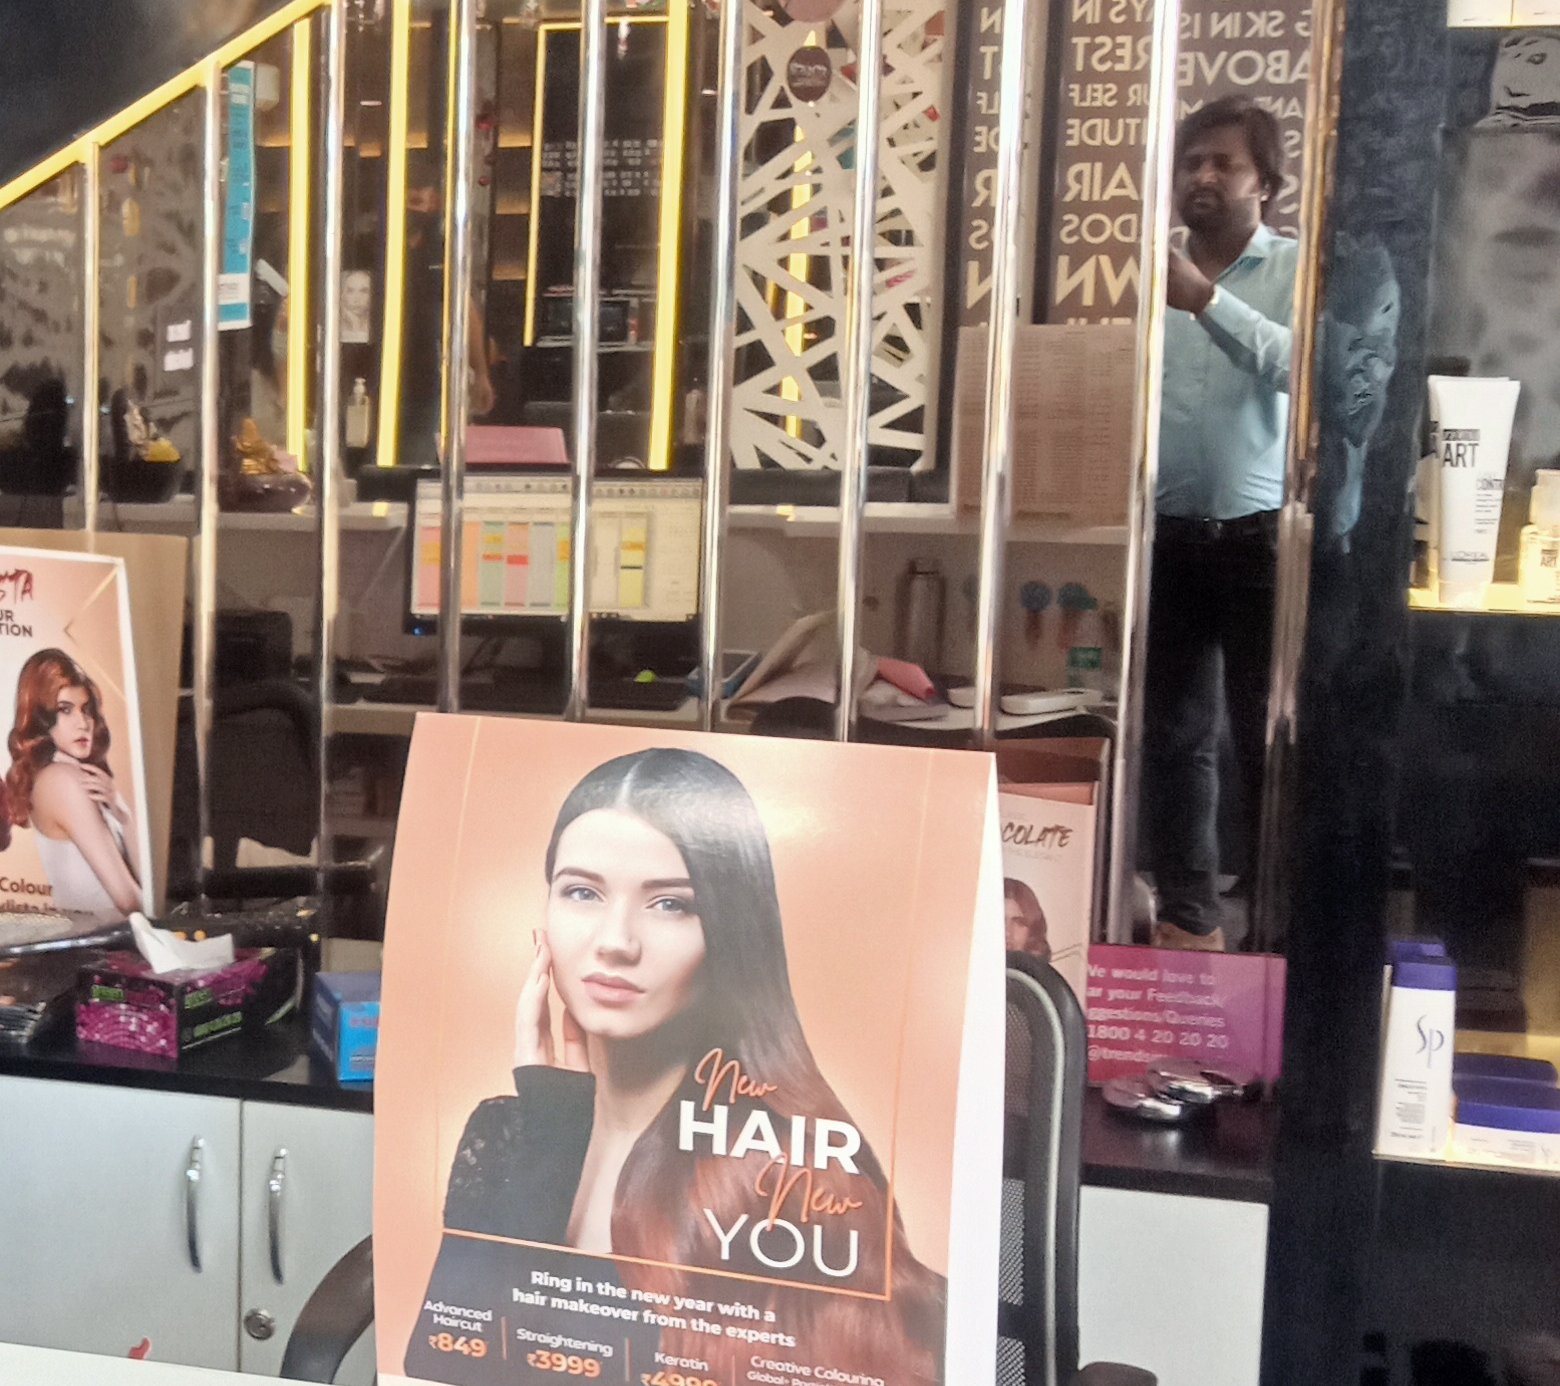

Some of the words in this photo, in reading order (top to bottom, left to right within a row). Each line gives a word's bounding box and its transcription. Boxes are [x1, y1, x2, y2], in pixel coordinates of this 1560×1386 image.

[1443, 443, 1480, 468] ART
[1002, 822, 1074, 848] COLATE
[1111, 967, 1159, 982] would
[1163, 969, 1195, 984] love
[1199, 973, 1216, 985] to
[1107, 989, 1143, 1002] your
[1088, 1024, 1131, 1041] 1800
[1134, 1028, 1147, 1041] 4
[1151, 1029, 1175, 1044] 20
[1179, 1032, 1202, 1047] 20
[1206, 1034, 1230, 1049] 20
[694, 1047, 778, 1111] New
[678, 1099, 862, 1175] HAIR
[755, 1153, 863, 1232] New
[702, 1207, 859, 1278] YOU
[530, 1270, 572, 1293] Ring
[575, 1276, 594, 1293] in
[596, 1280, 627, 1299] the
[631, 1289, 671, 1306] new
[673, 1295, 715, 1313] year
[717, 1301, 761, 1322] with
[763, 1310, 776, 1323] a
[423, 1300, 493, 1322] Advanced
[433, 1314, 483, 1333] Haircut
[512, 1288, 548, 1306] hair
[550, 1295, 640, 1322] makeover
[642, 1310, 687, 1330] from
[690, 1317, 722, 1336] the
[726, 1325, 796, 1348] experts
[516, 1328, 614, 1358] Straightening
[654, 1352, 709, 1372] Keratin
[750, 1356, 812, 1377] Creative
